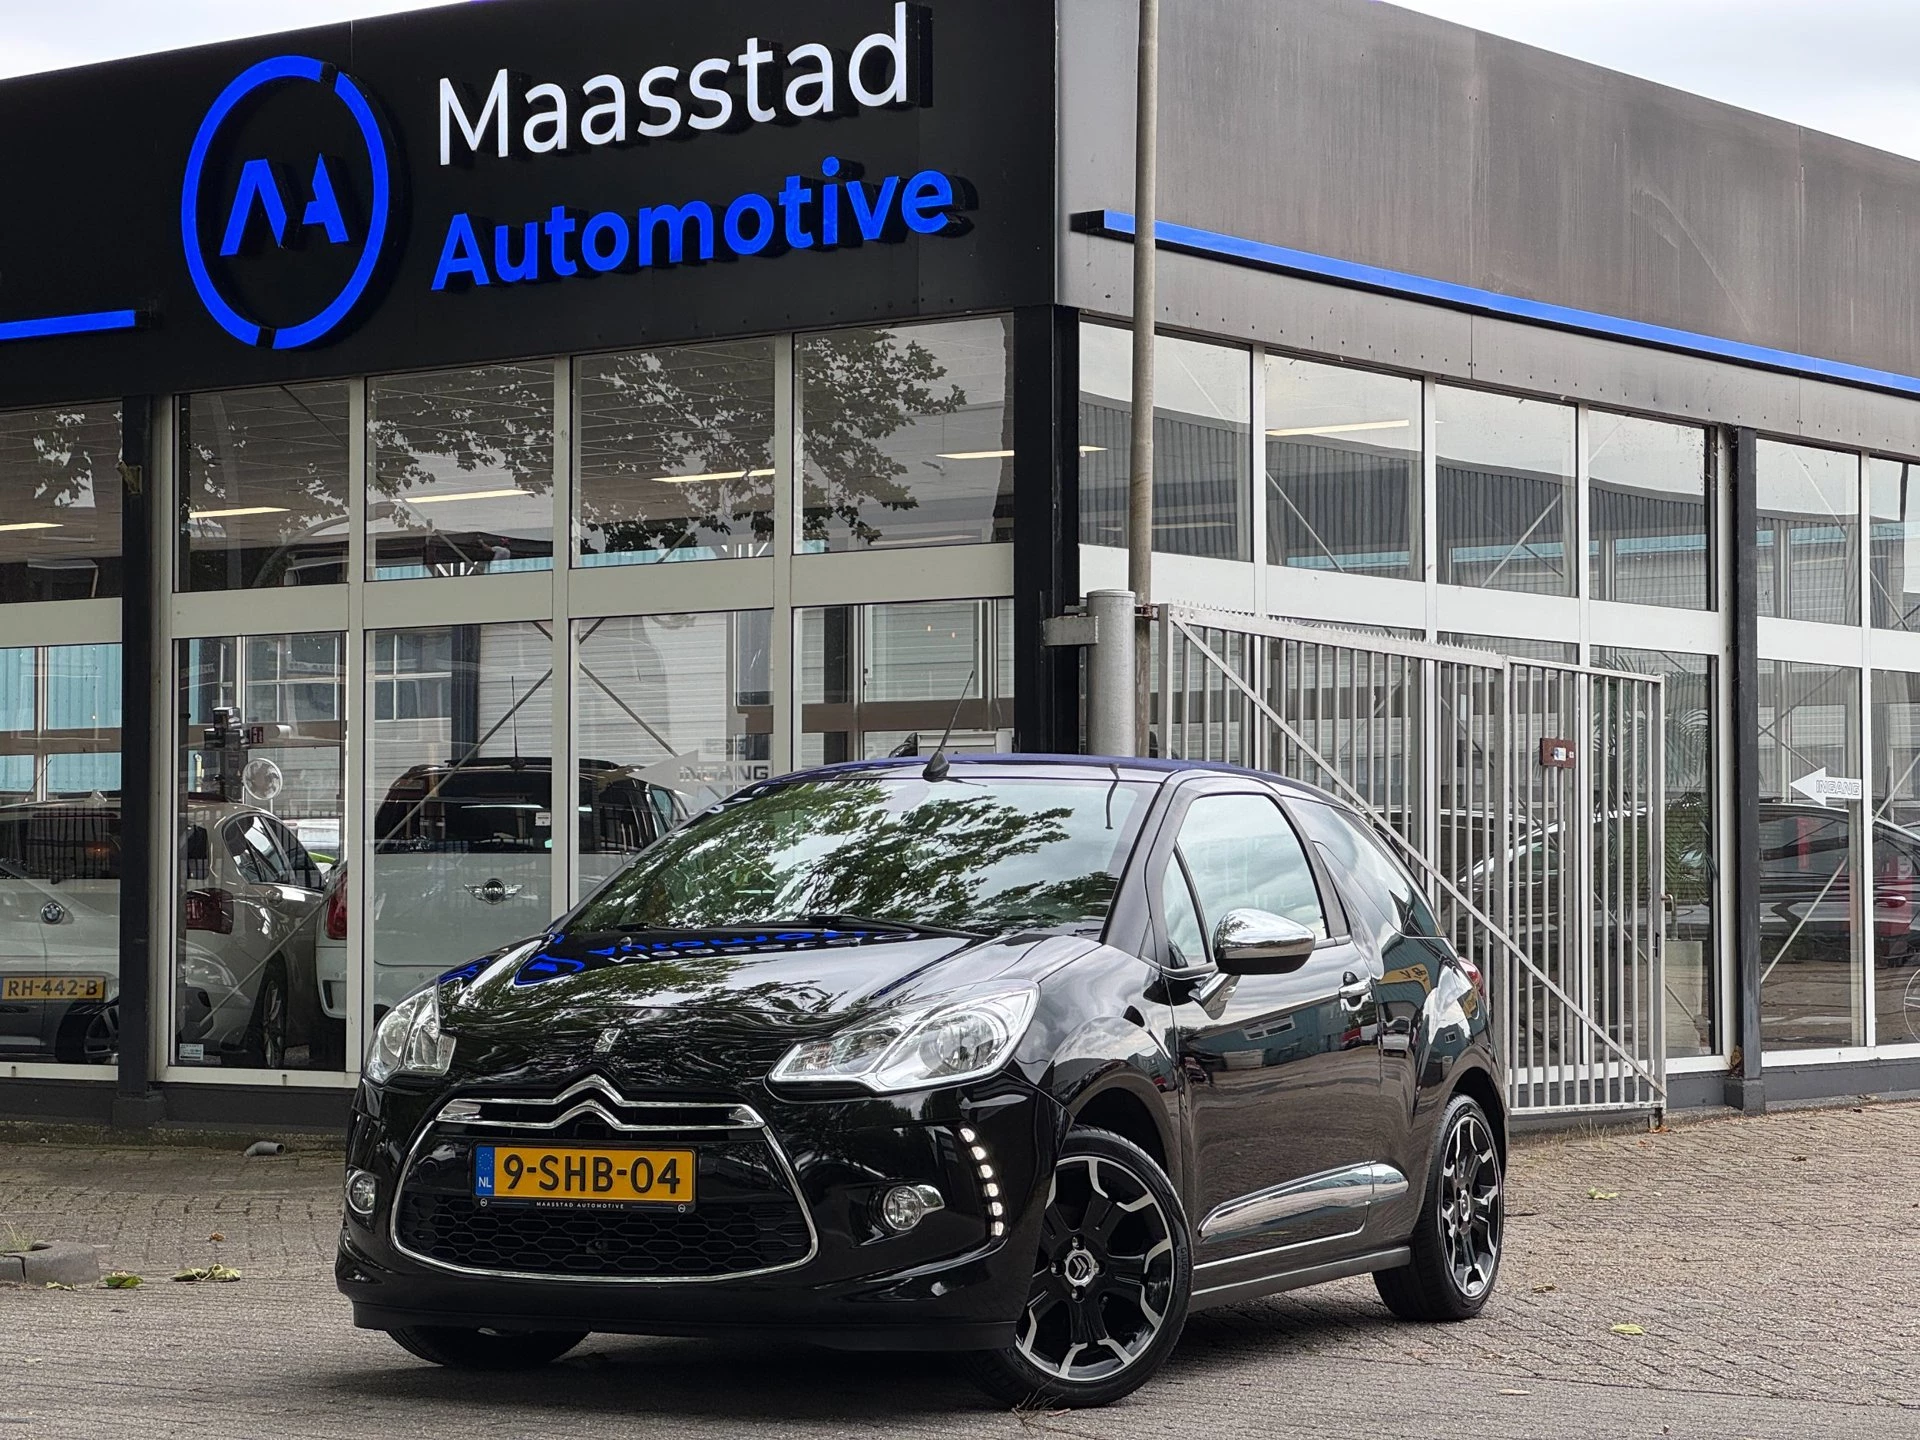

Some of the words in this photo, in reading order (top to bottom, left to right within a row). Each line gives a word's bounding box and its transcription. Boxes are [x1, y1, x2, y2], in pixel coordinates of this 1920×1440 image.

[439, 2, 907, 166] Maasstad
[431, 156, 953, 291] Automotive
[1815, 779, 1861, 796] INGANG
[7, 979, 98, 997] RH-442-B
[478, 1176, 492, 1188] NL
[503, 1153, 681, 1195] 9-SHB-04
